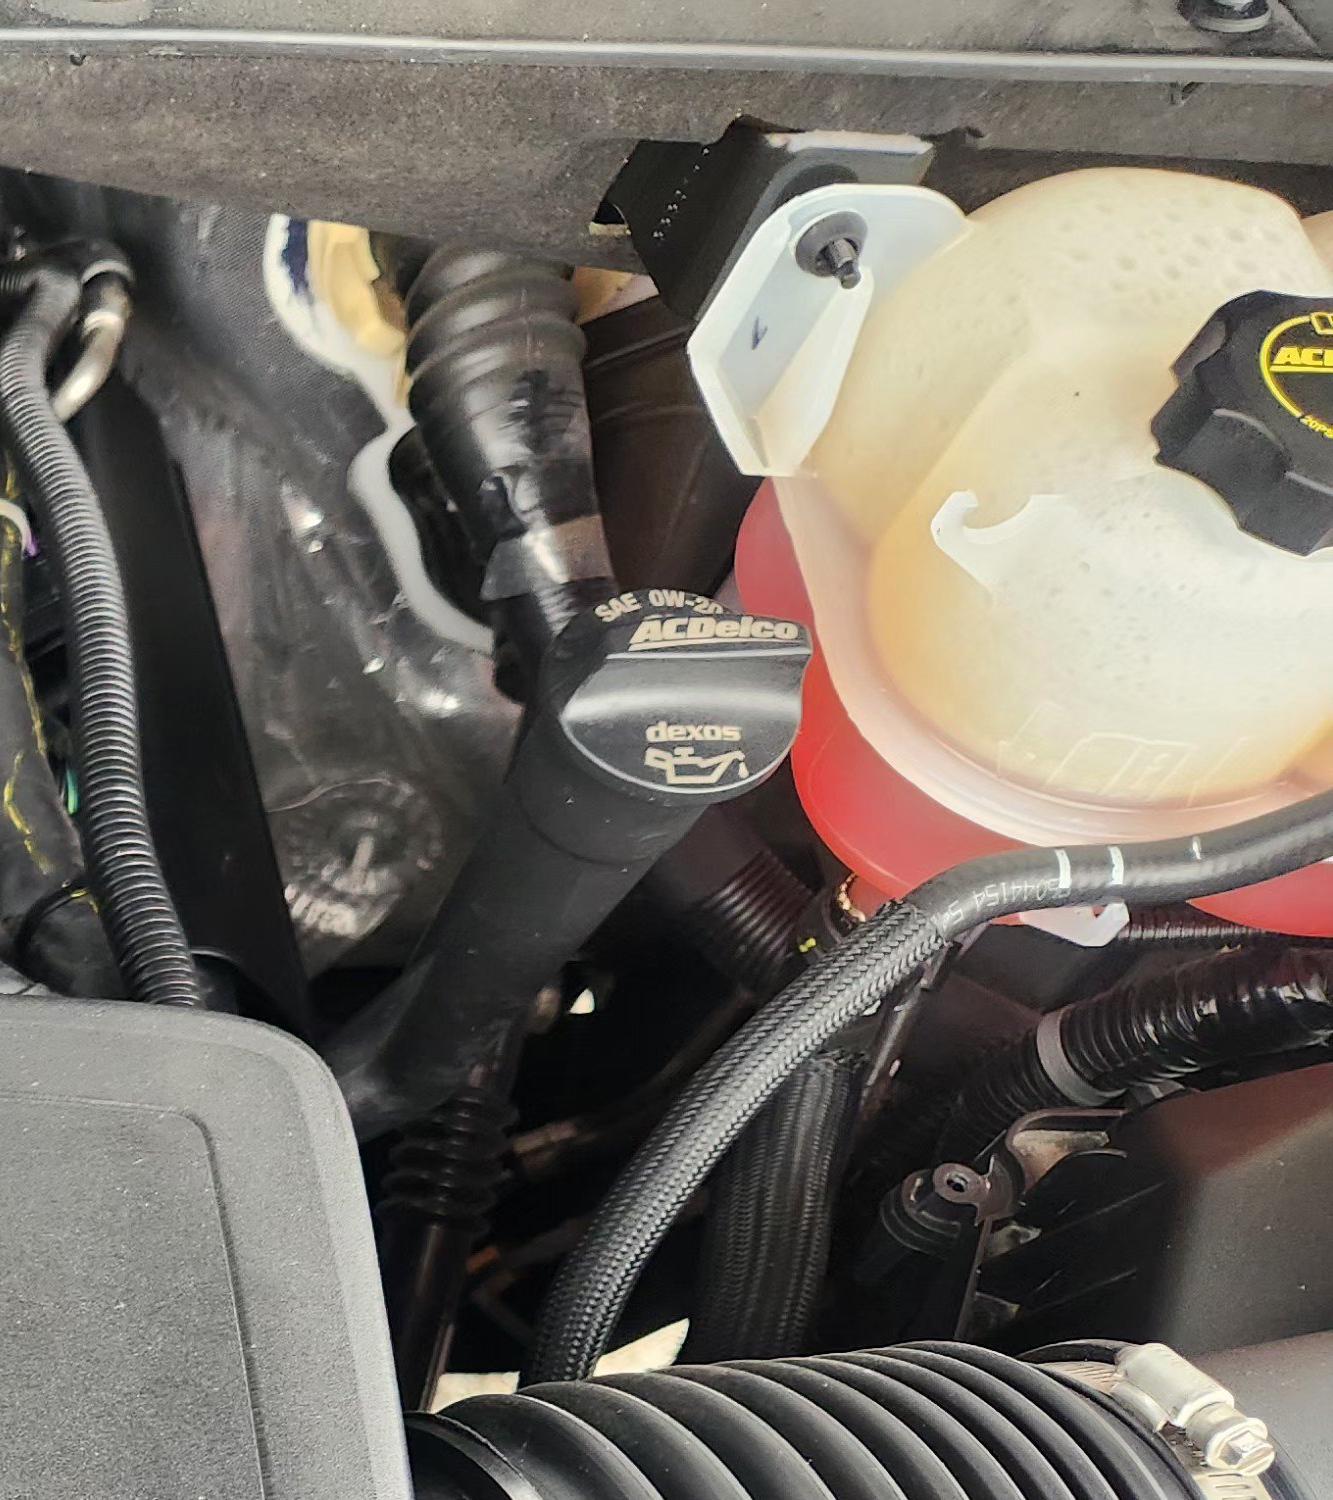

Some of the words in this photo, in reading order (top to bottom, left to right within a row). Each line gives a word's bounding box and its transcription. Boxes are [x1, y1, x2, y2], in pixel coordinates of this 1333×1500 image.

[594, 592, 642, 623] SAE
[630, 616, 799, 643] ACDelco
[645, 720, 742, 743] dexos
